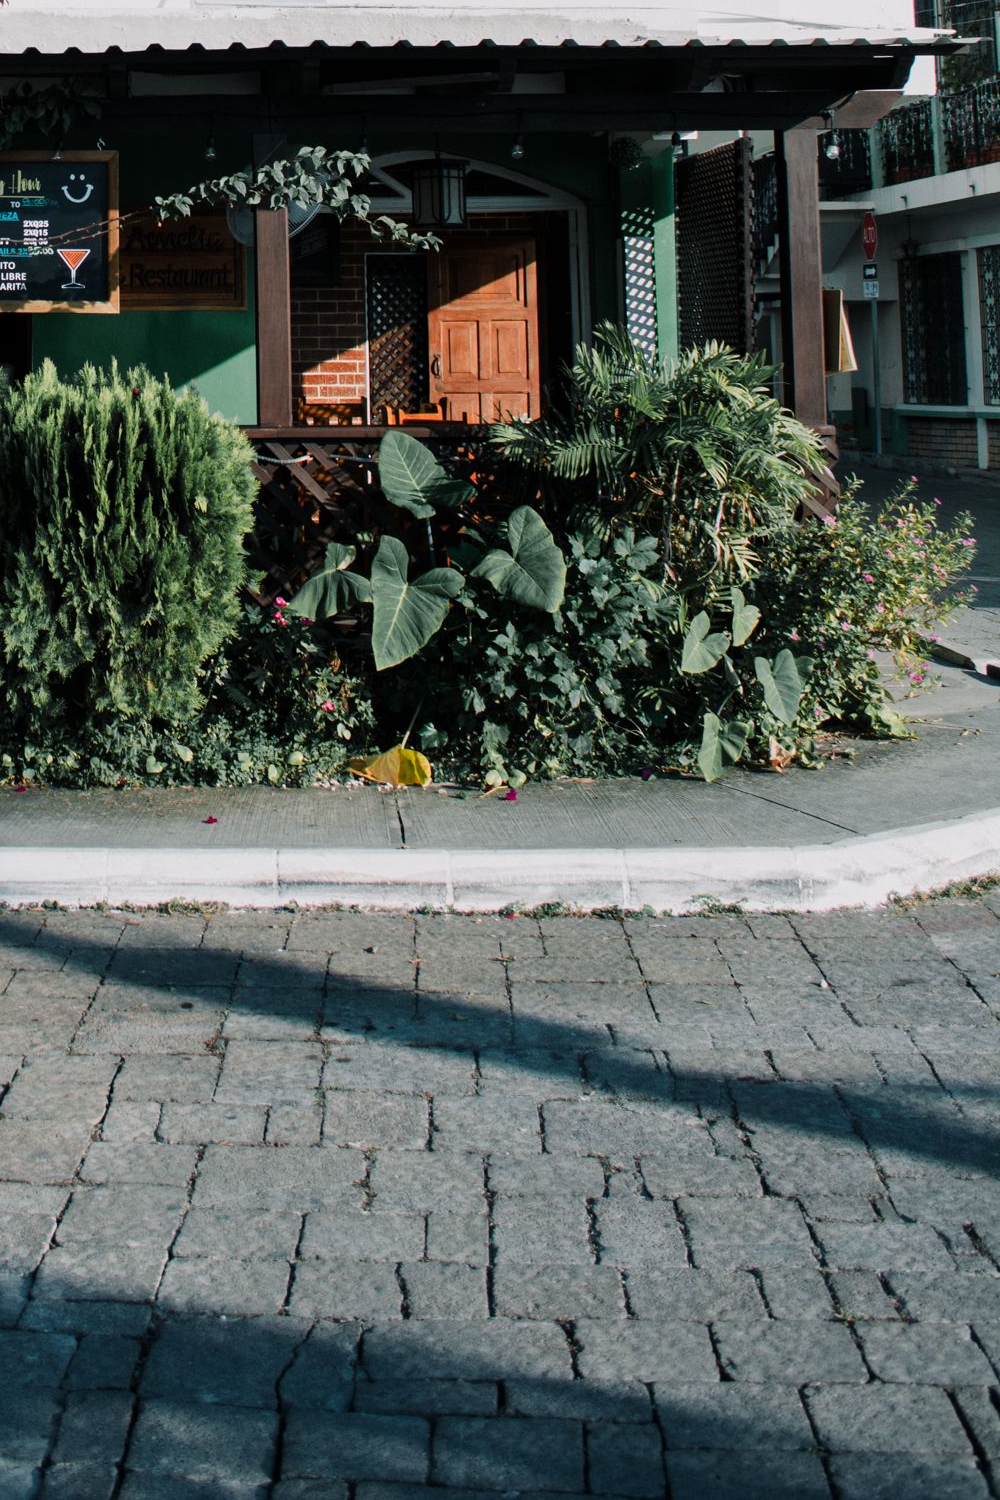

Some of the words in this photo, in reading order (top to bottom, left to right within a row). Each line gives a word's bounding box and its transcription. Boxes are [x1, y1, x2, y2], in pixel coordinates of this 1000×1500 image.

[8, 169, 42, 194] Hour
[23, 220, 49, 229] 2XQ25
[23, 229, 48, 238] 2XQ15
[863, 227, 876, 244] ALTO
[1, 272, 27, 280] LIBRE
